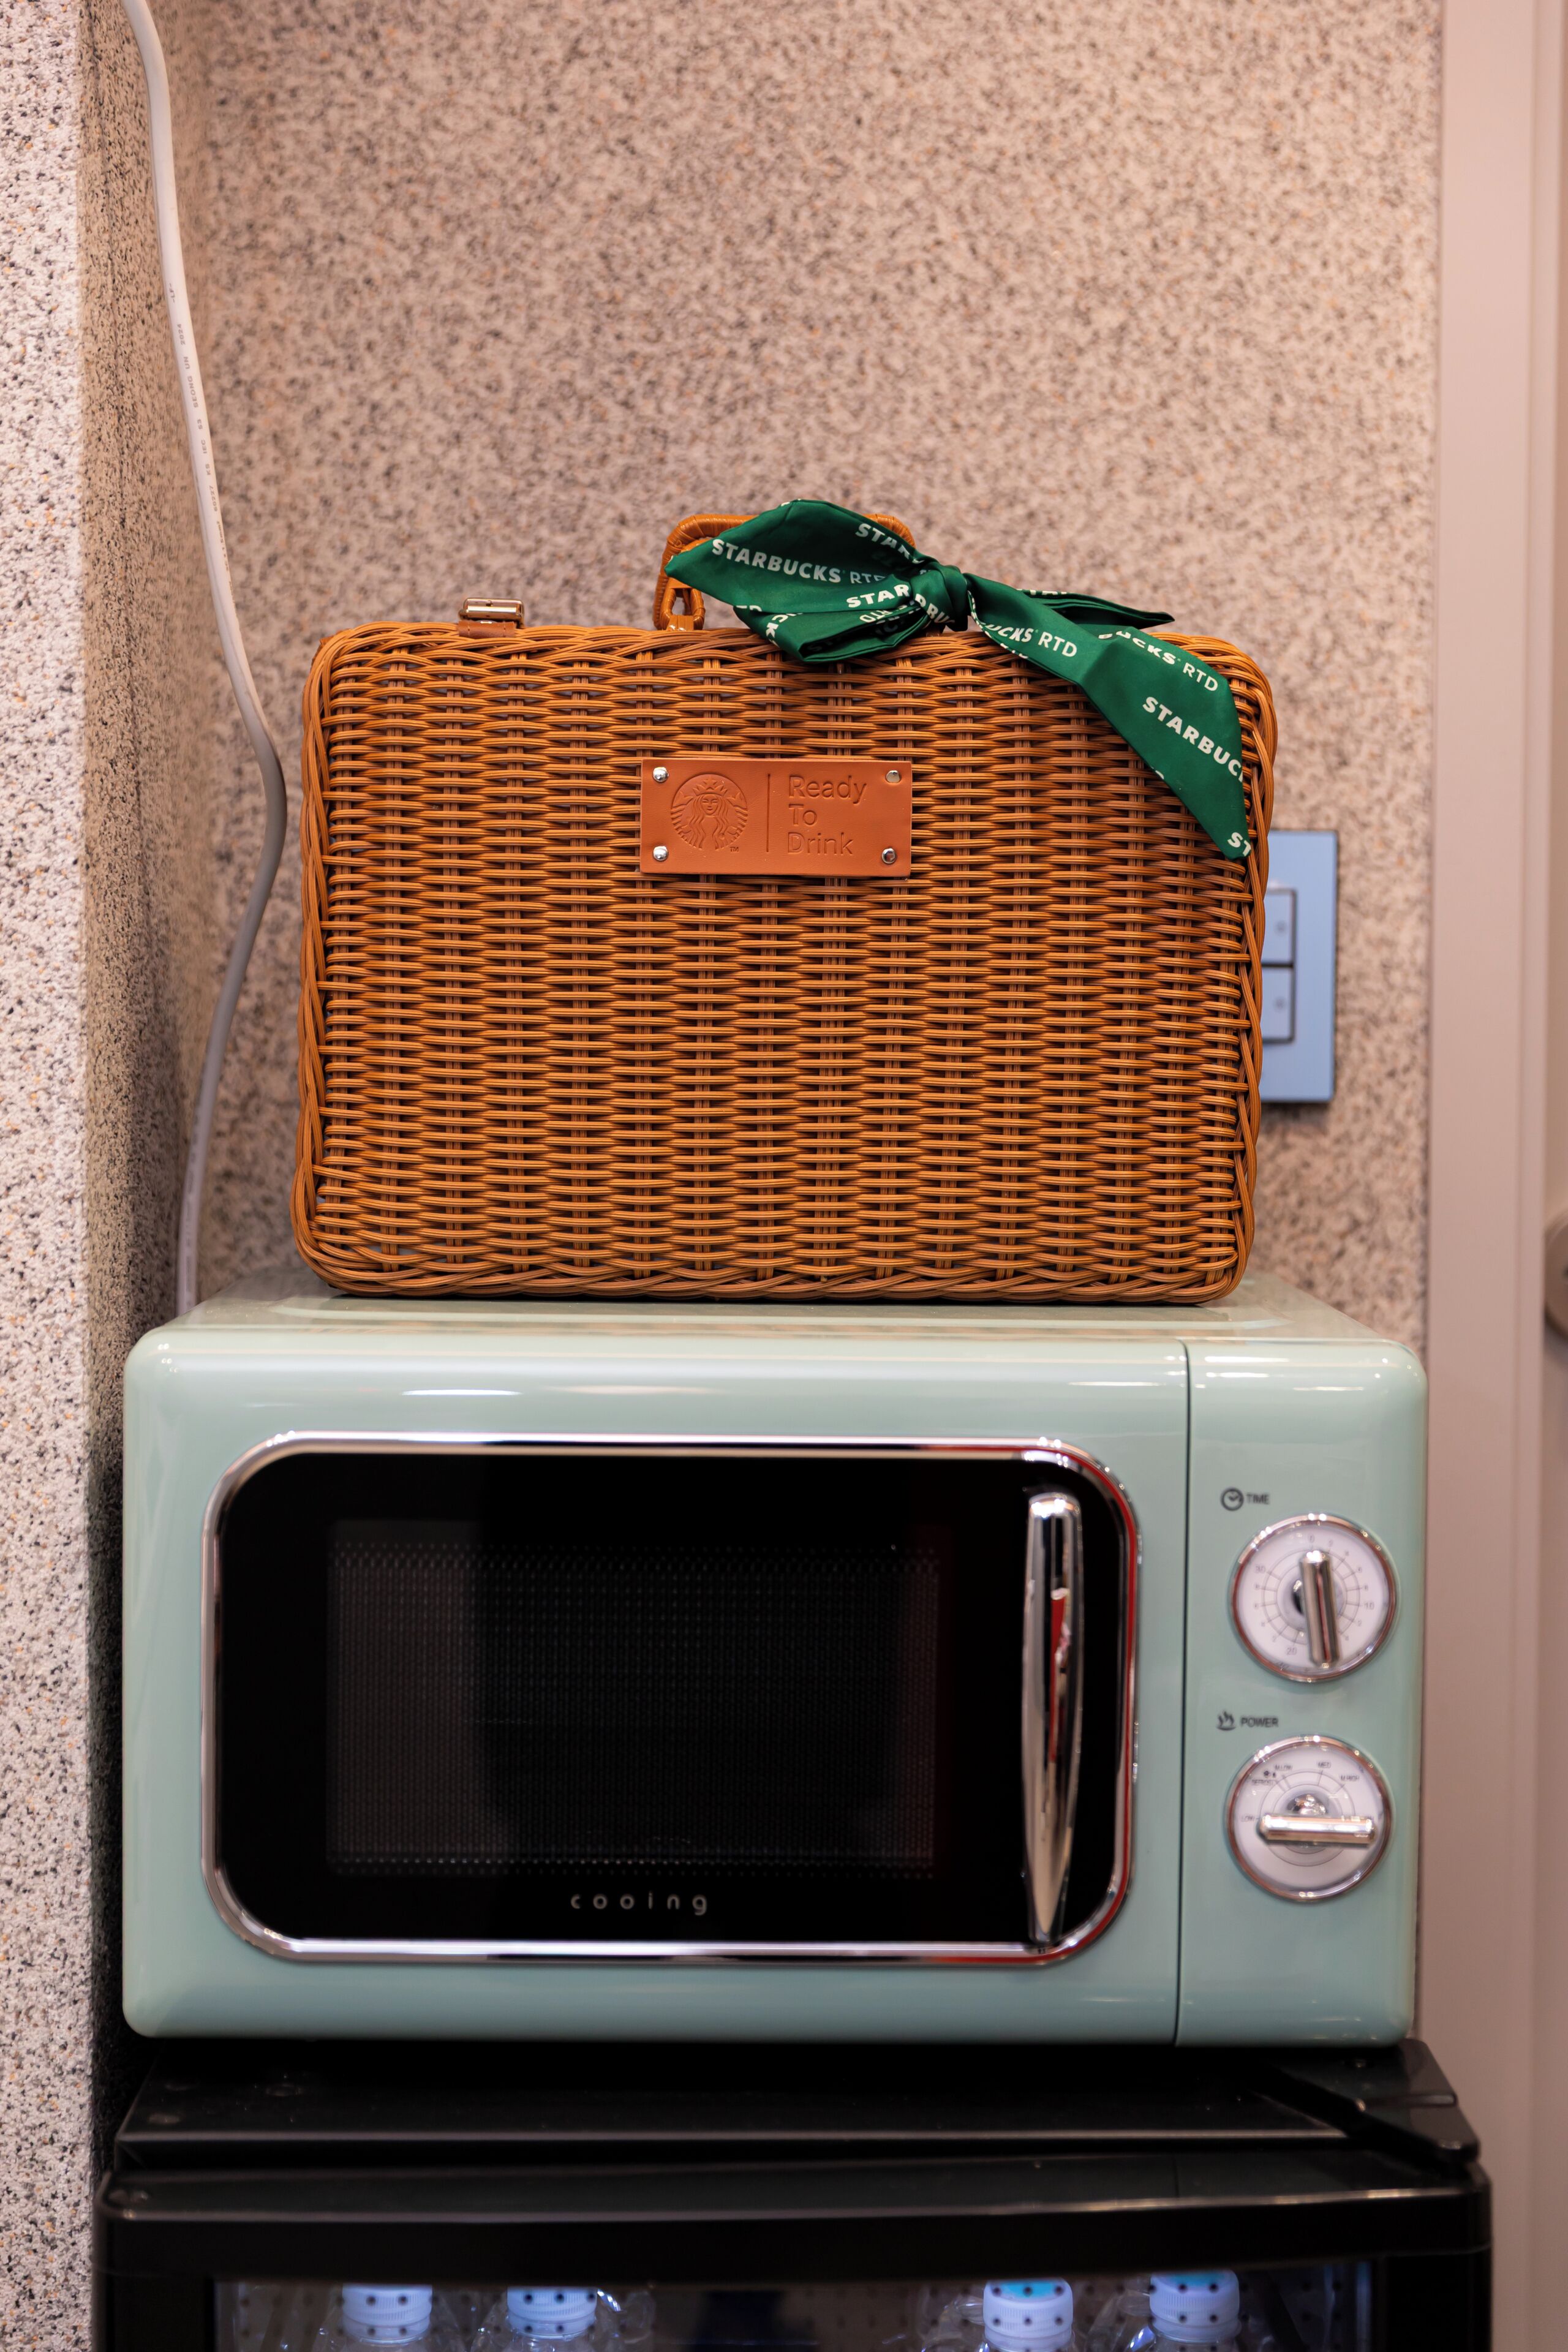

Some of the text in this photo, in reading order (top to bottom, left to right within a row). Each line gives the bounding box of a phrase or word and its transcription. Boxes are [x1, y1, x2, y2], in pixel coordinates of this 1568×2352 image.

[712, 538, 842, 583] STARBUCKS
[1038, 631, 1077, 657] RTD
[1182, 662, 1218, 698] RTD
[788, 775, 867, 804] Ready
[788, 804, 818, 826] To
[788, 832, 853, 856] Drink
[1246, 1493, 1270, 1505] TIME
[1240, 1716, 1279, 1728] POWER
[570, 1891, 707, 1915] cooing
